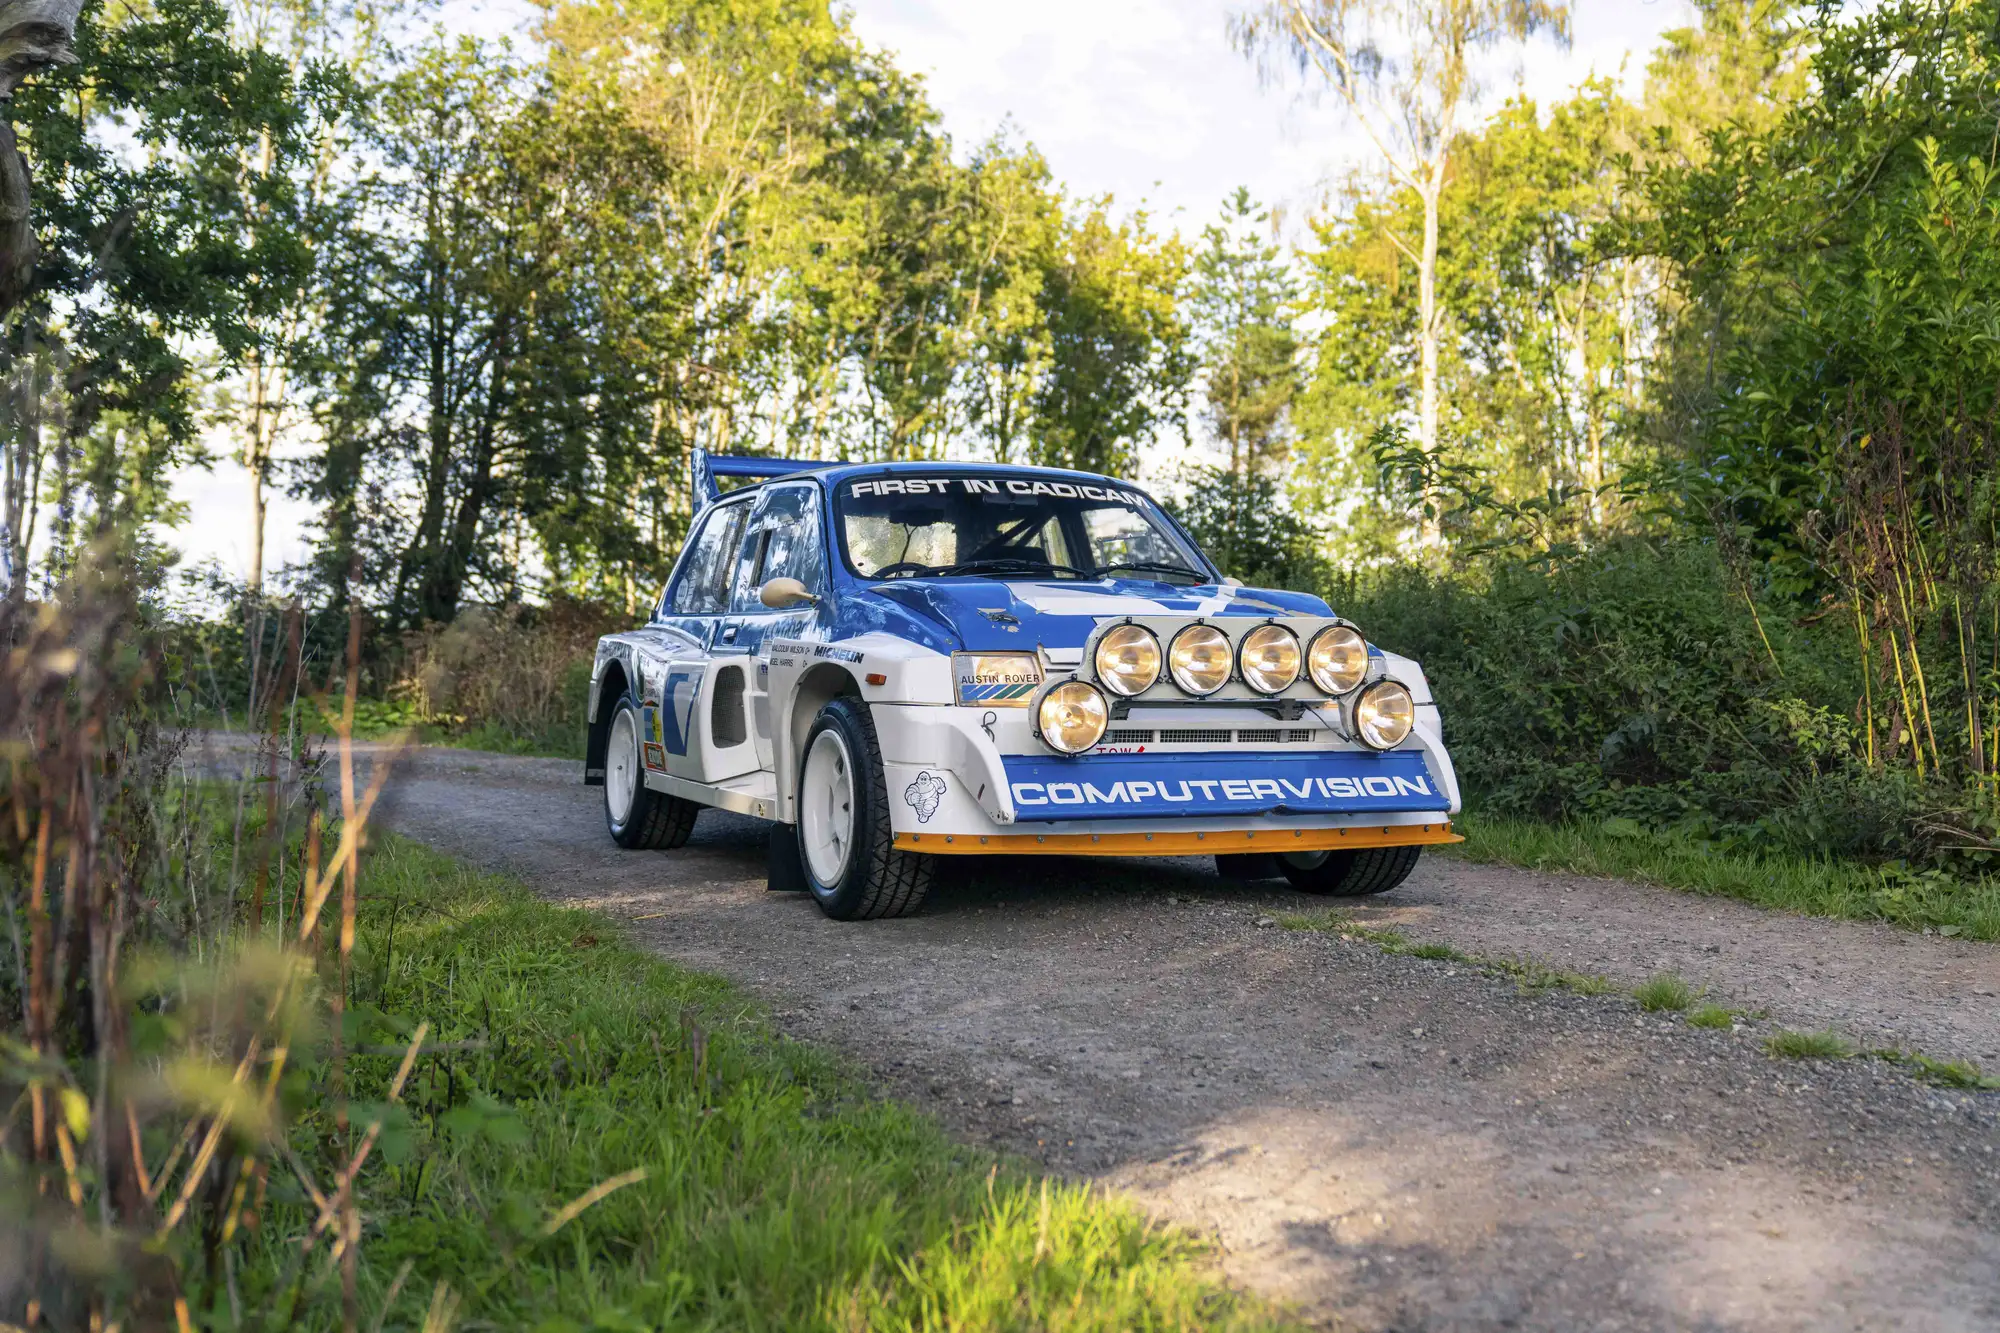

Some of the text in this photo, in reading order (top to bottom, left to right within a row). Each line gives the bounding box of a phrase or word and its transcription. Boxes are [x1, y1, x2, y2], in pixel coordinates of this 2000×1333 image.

[851, 479, 950, 498] FIRST
[962, 479, 1000, 494] IN
[814, 645, 865, 664] MICHELIN
[961, 674, 1040, 684] AUSTIN ROVER
[1010, 775, 1433, 805] COMPUTERVISION
